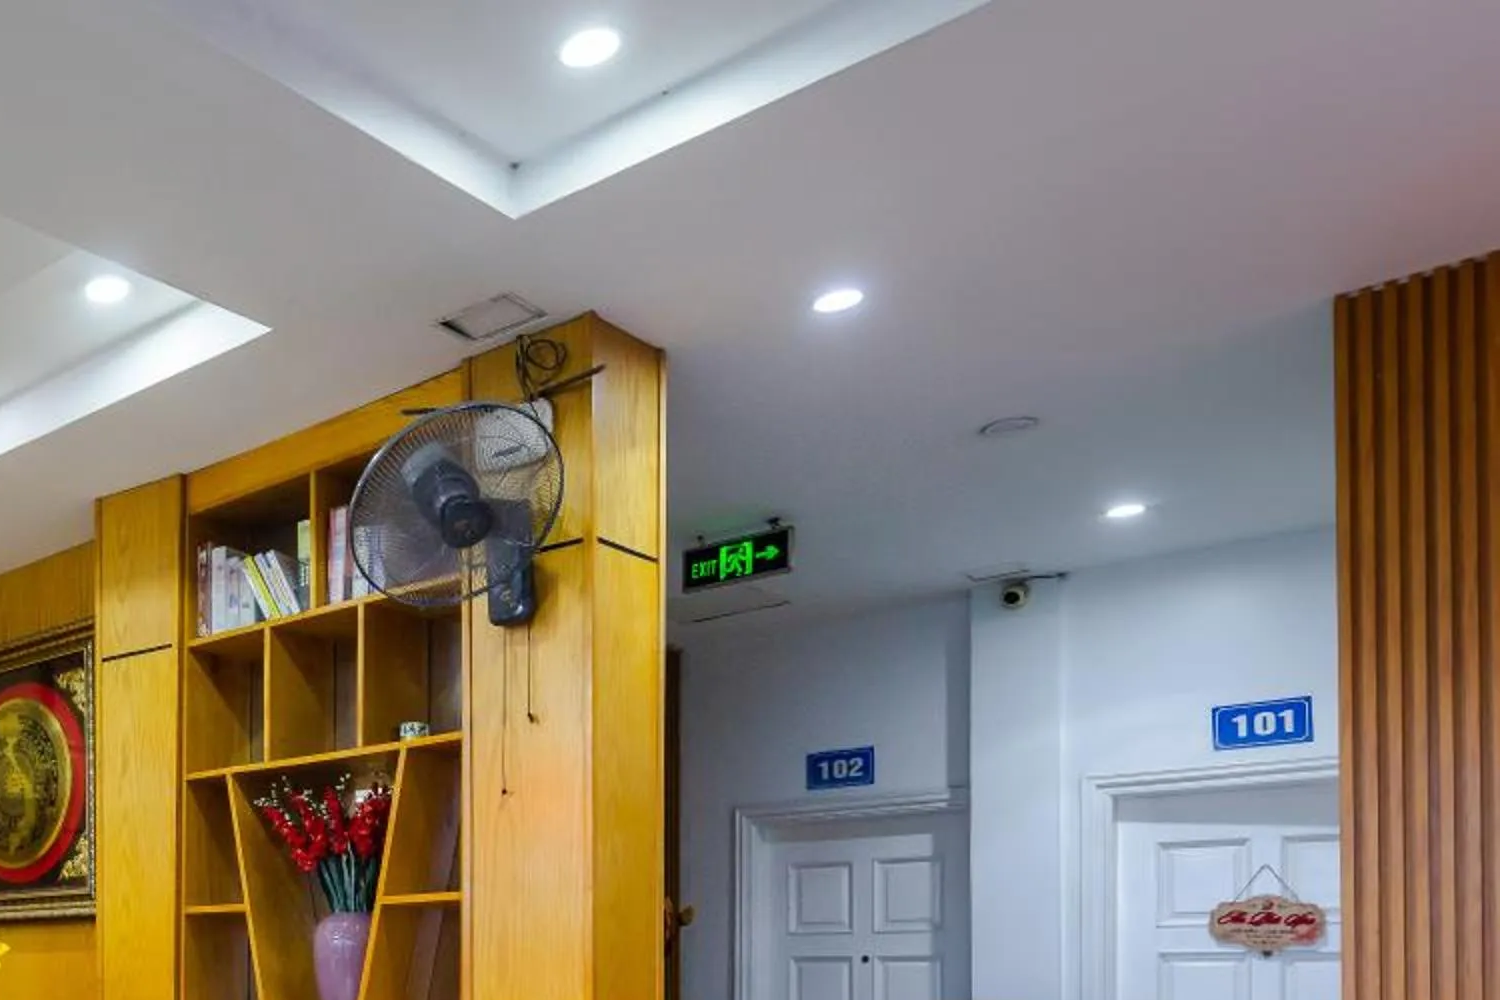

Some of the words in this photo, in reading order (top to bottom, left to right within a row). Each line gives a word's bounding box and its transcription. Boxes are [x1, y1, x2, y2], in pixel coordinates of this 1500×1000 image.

[691, 559, 717, 579] EXIT
[1231, 709, 1294, 738] 101
[817, 757, 864, 780] 102
